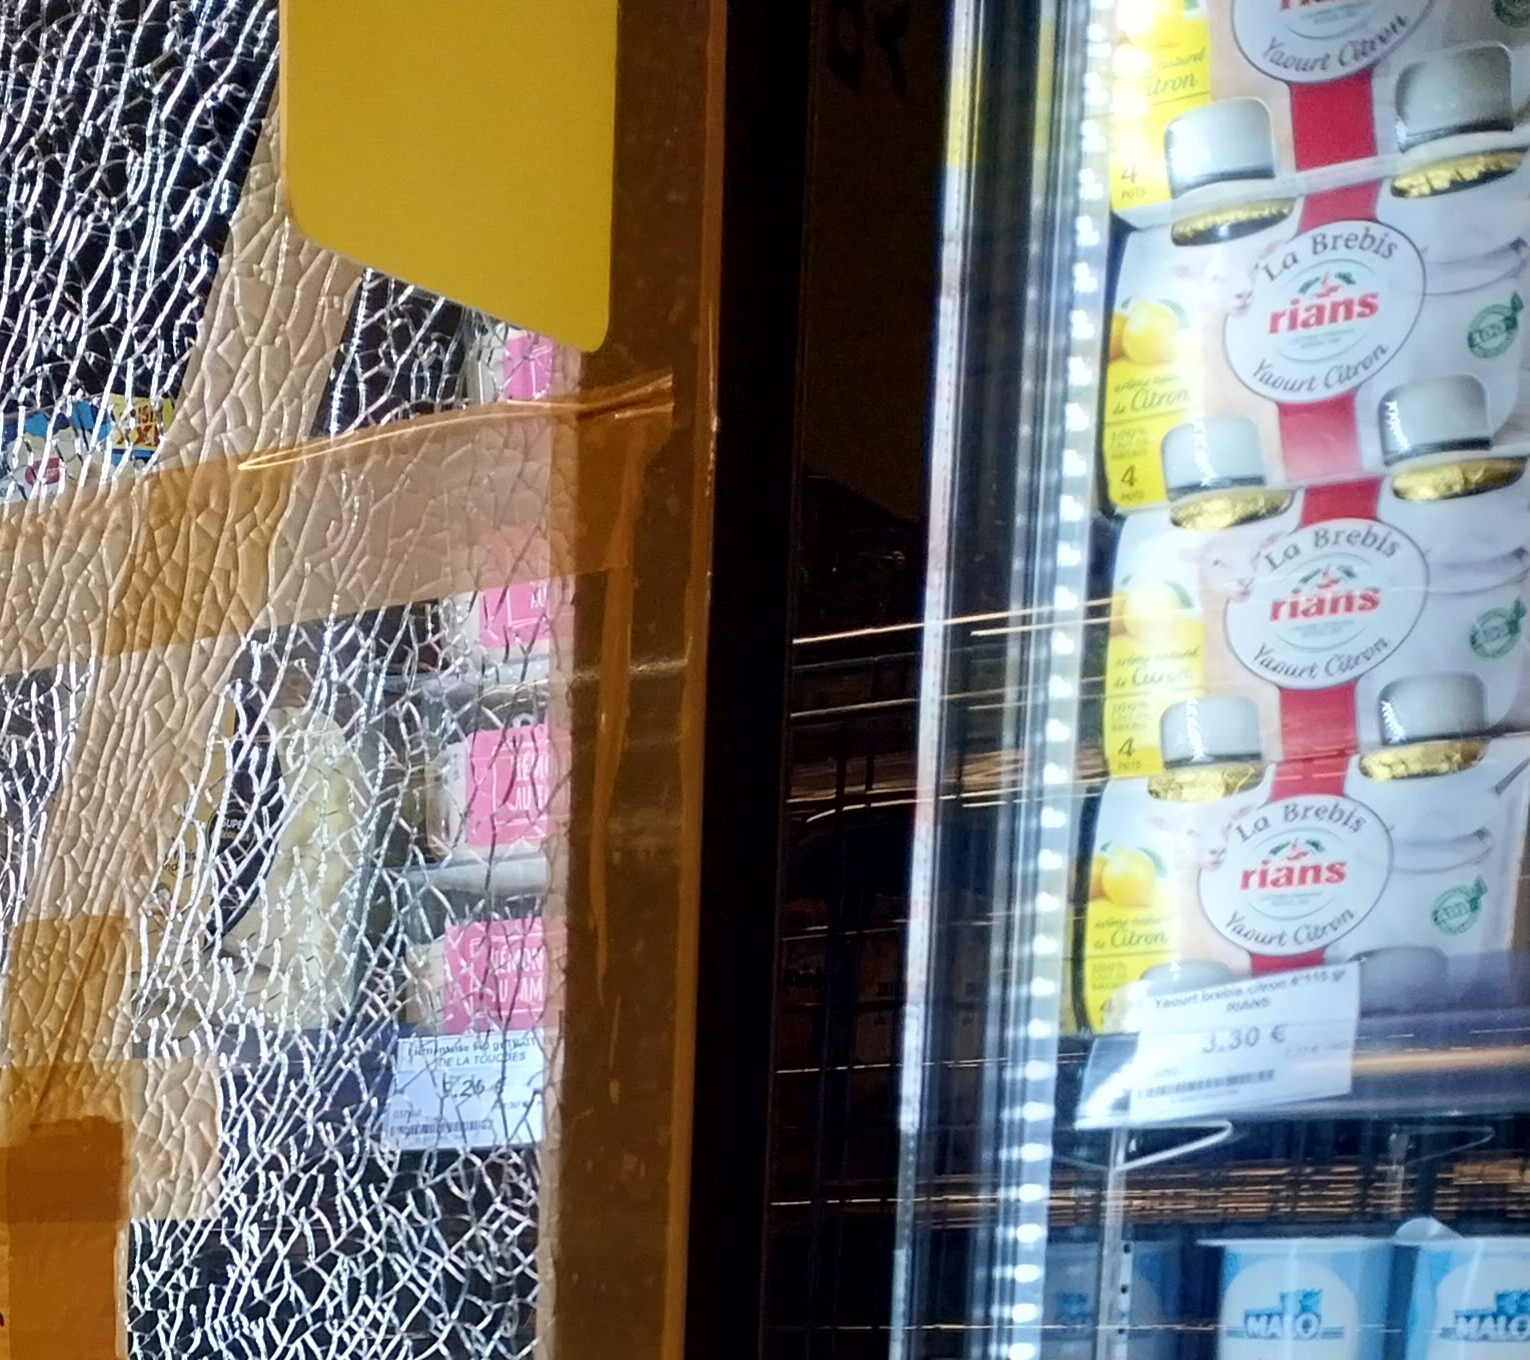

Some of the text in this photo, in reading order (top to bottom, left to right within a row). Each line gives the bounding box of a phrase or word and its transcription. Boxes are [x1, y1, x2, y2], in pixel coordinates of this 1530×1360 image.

[1262, 12, 1408, 72] Yaourt Citron
[1120, 161, 1139, 184] 4
[1262, 227, 1399, 283] La Brebis
[1267, 288, 1381, 336] rians
[1250, 341, 1390, 395] Yaourt Citron
[1130, 387, 1191, 414] Citron
[1120, 464, 1138, 488] 4
[1264, 527, 1401, 572] La Brebis
[1269, 584, 1383, 624] rians
[1251, 636, 1393, 681] Yaourt Citron
[1117, 735, 1137, 760] 4
[1234, 800, 1367, 844] La Brebis
[1238, 855, 1349, 893] rians
[1109, 929, 1169, 950] Citron
[1222, 907, 1357, 947] Yaourt Citron
[1202, 1027, 1261, 1054] 3.30
[1271, 1023, 1289, 1043] €
[456, 1055, 473, 1066] LA
